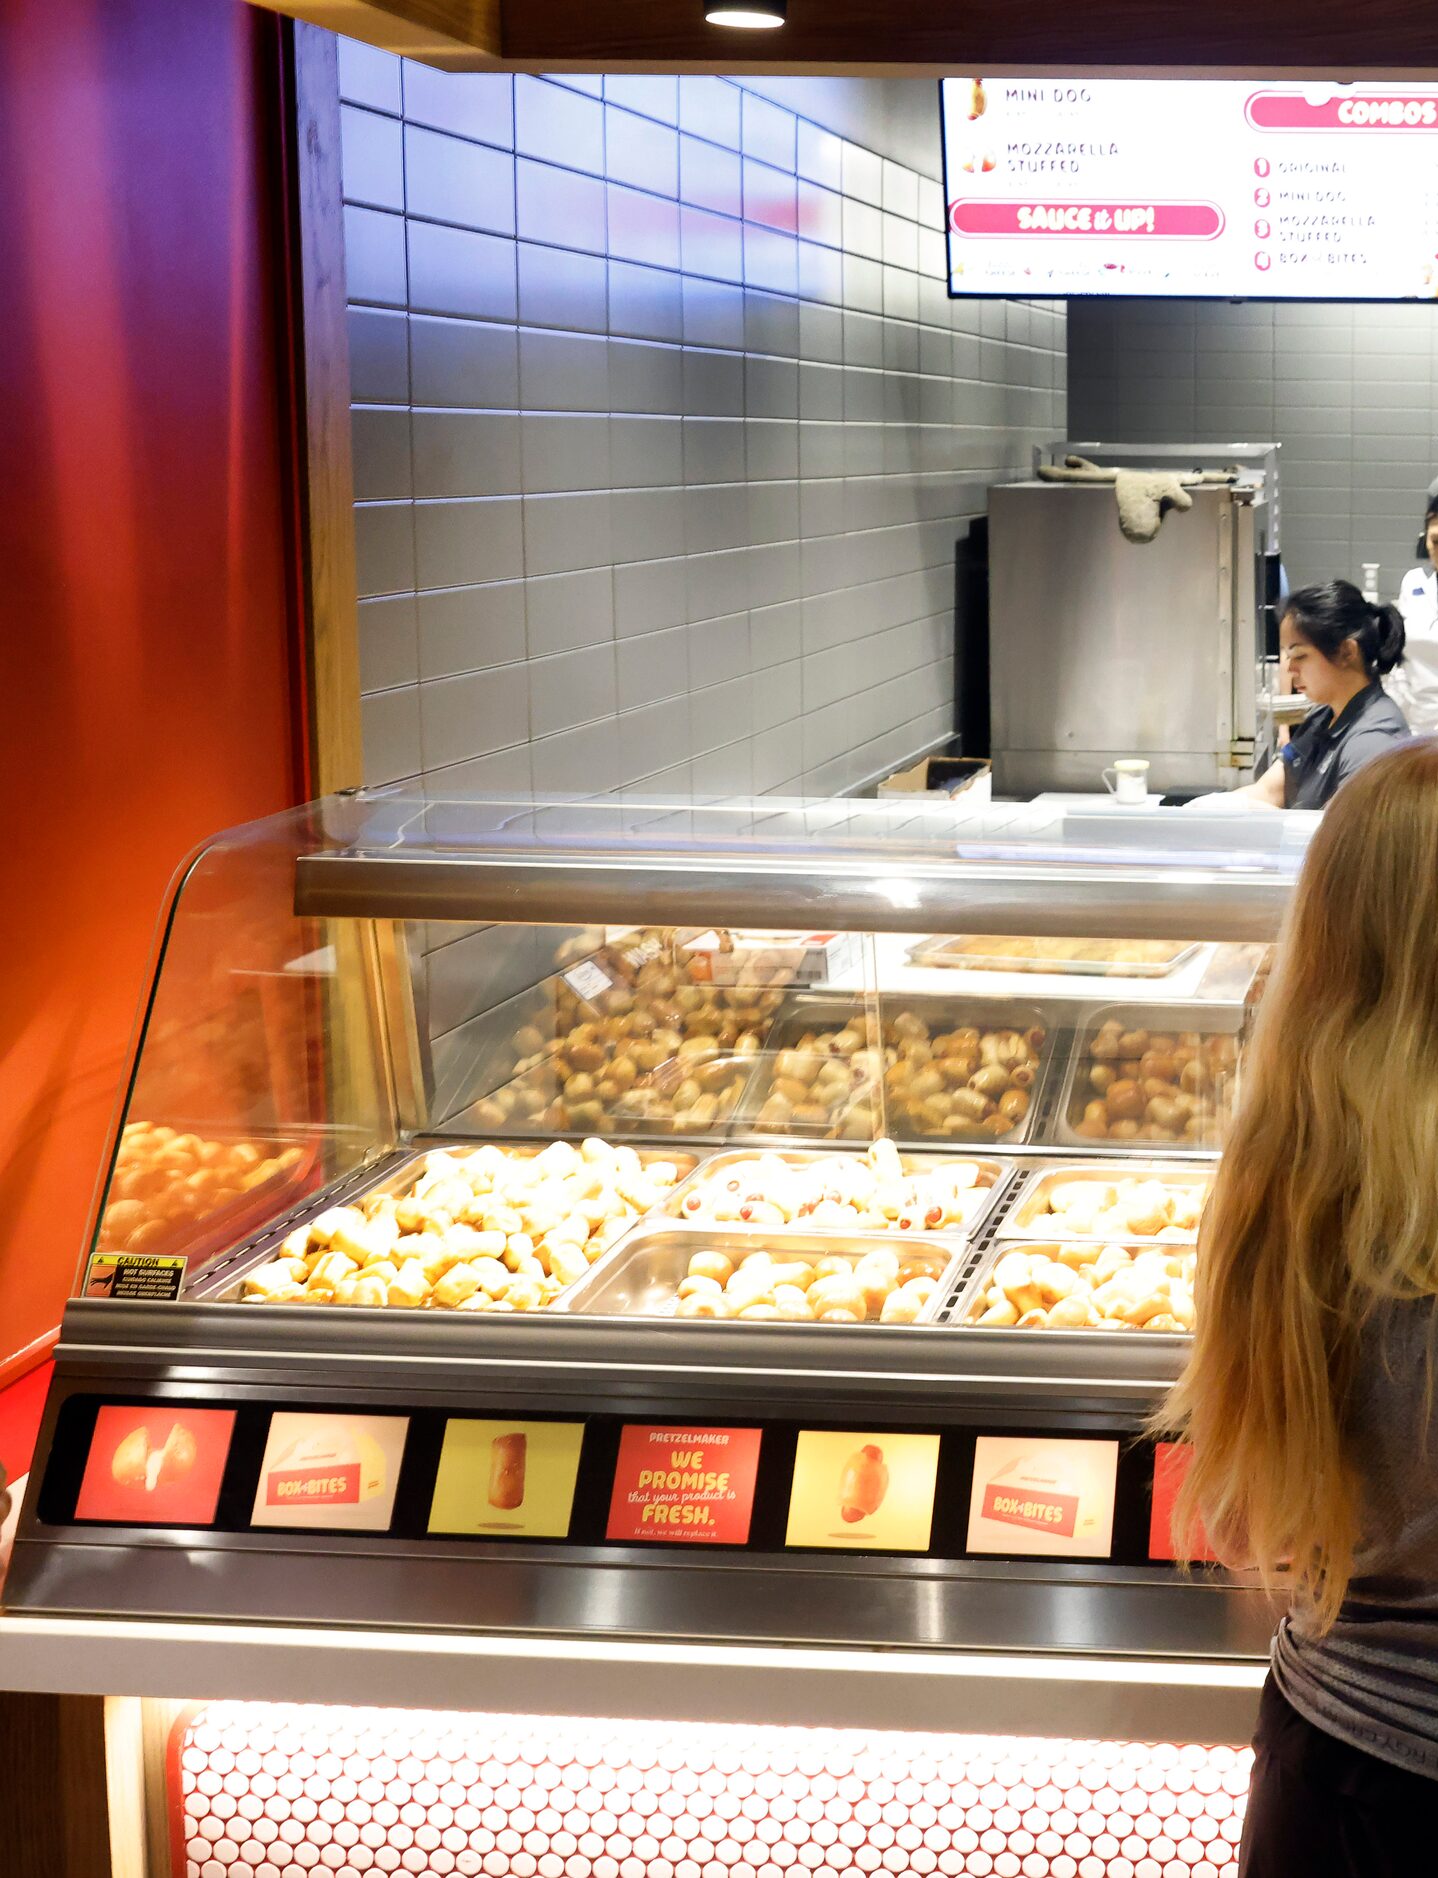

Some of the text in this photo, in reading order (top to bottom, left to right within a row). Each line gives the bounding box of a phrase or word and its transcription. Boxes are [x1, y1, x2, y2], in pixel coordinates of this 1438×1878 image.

[1006, 88, 1092, 103] MINI DOG
[1337, 100, 1437, 125] COMBOS
[1007, 142, 1120, 156] MOZZARELLA
[1007, 159, 1080, 174] STUFFED
[1016, 207, 1093, 231] SAUCE
[1114, 207, 1156, 232] UP!
[117, 1256, 160, 1267] CAUTION
[649, 1432, 730, 1446] PRETZELMAKER
[670, 1450, 704, 1470] WE
[277, 1480, 302, 1497] BOX
[308, 1477, 347, 1495] BITES
[638, 1470, 730, 1491] PROMISE
[628, 1488, 737, 1506] that your product is
[641, 1504, 716, 1526] FRESH.
[993, 1496, 1018, 1515] BOX
[1023, 1501, 1064, 1523] BITES
